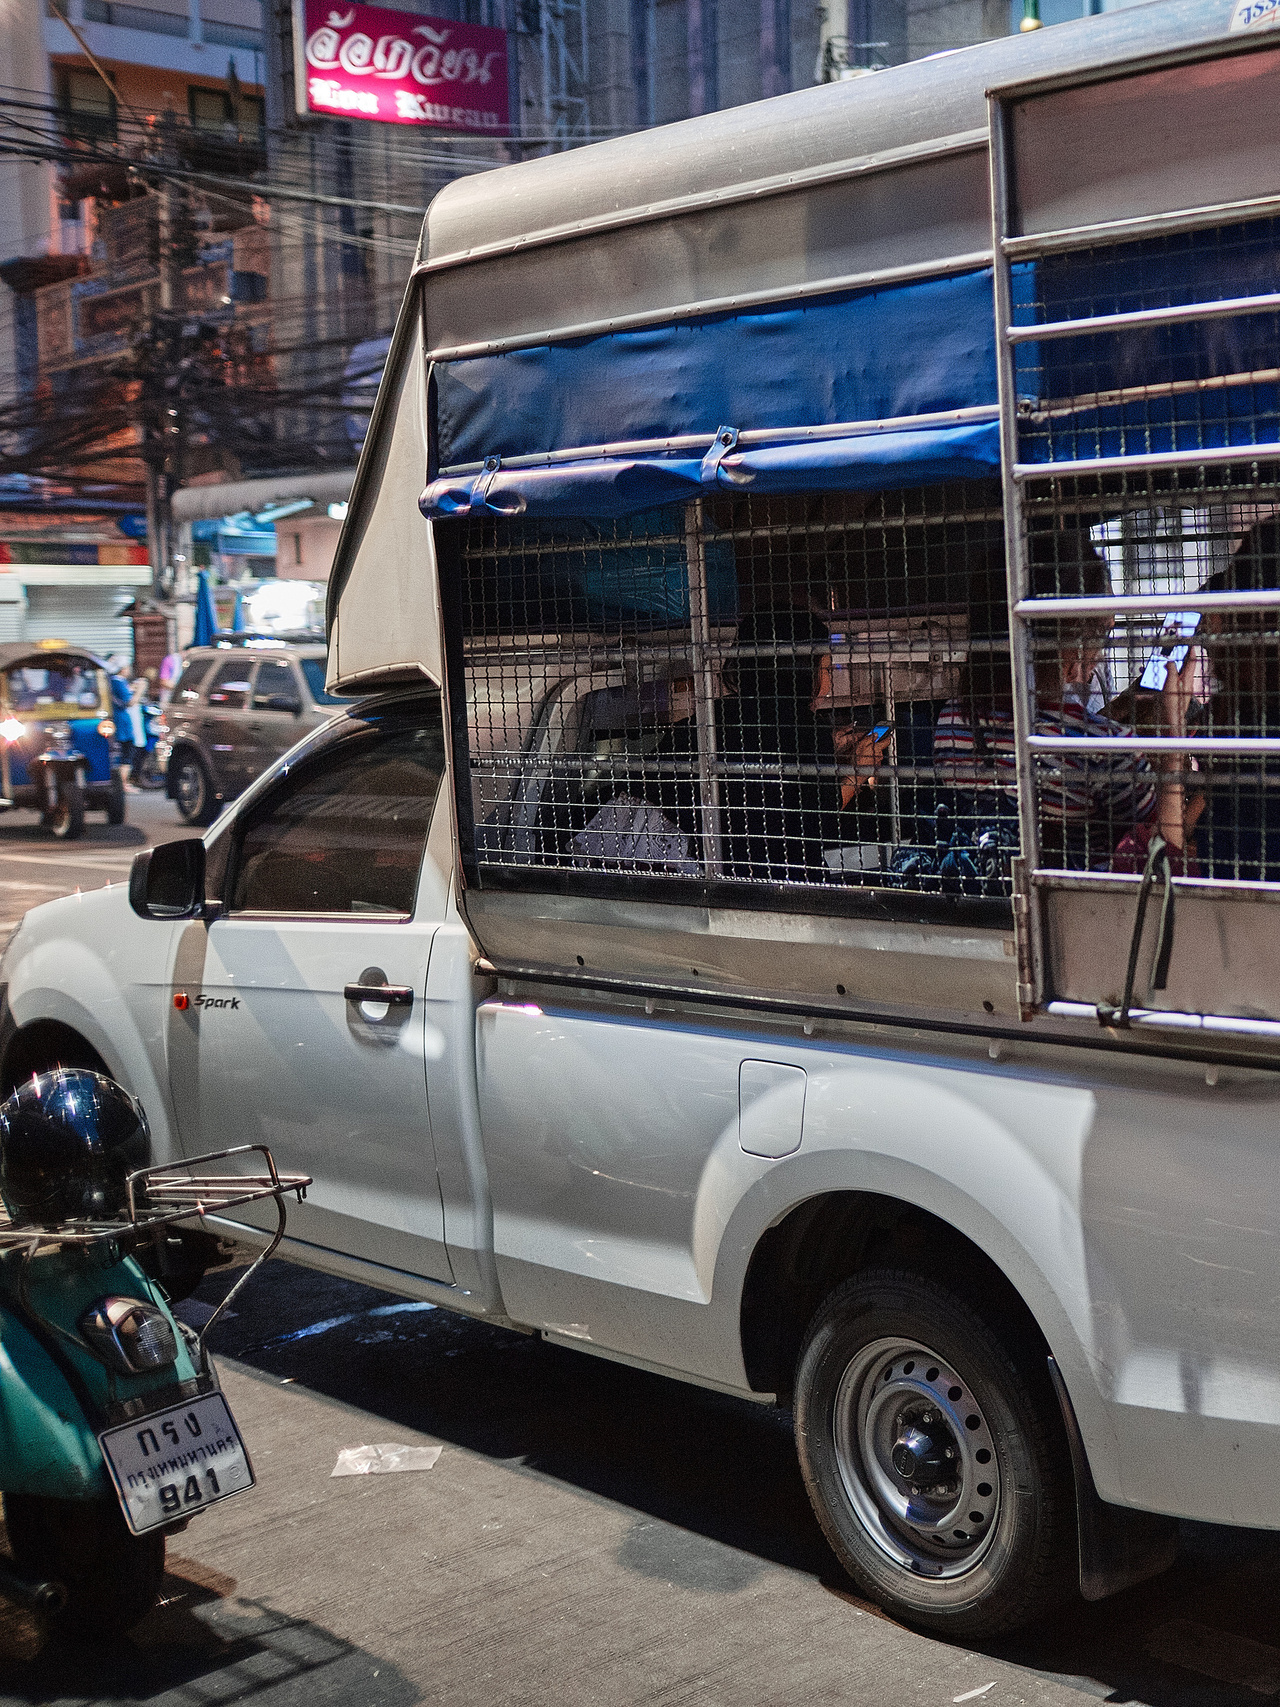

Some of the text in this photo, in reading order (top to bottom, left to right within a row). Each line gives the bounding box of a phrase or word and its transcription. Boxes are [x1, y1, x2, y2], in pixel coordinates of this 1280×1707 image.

[194, 994, 241, 1010] Spark
[126, 1435, 236, 1490] กรุงเทพมหานคร
[158, 1467, 221, 1514] 941
